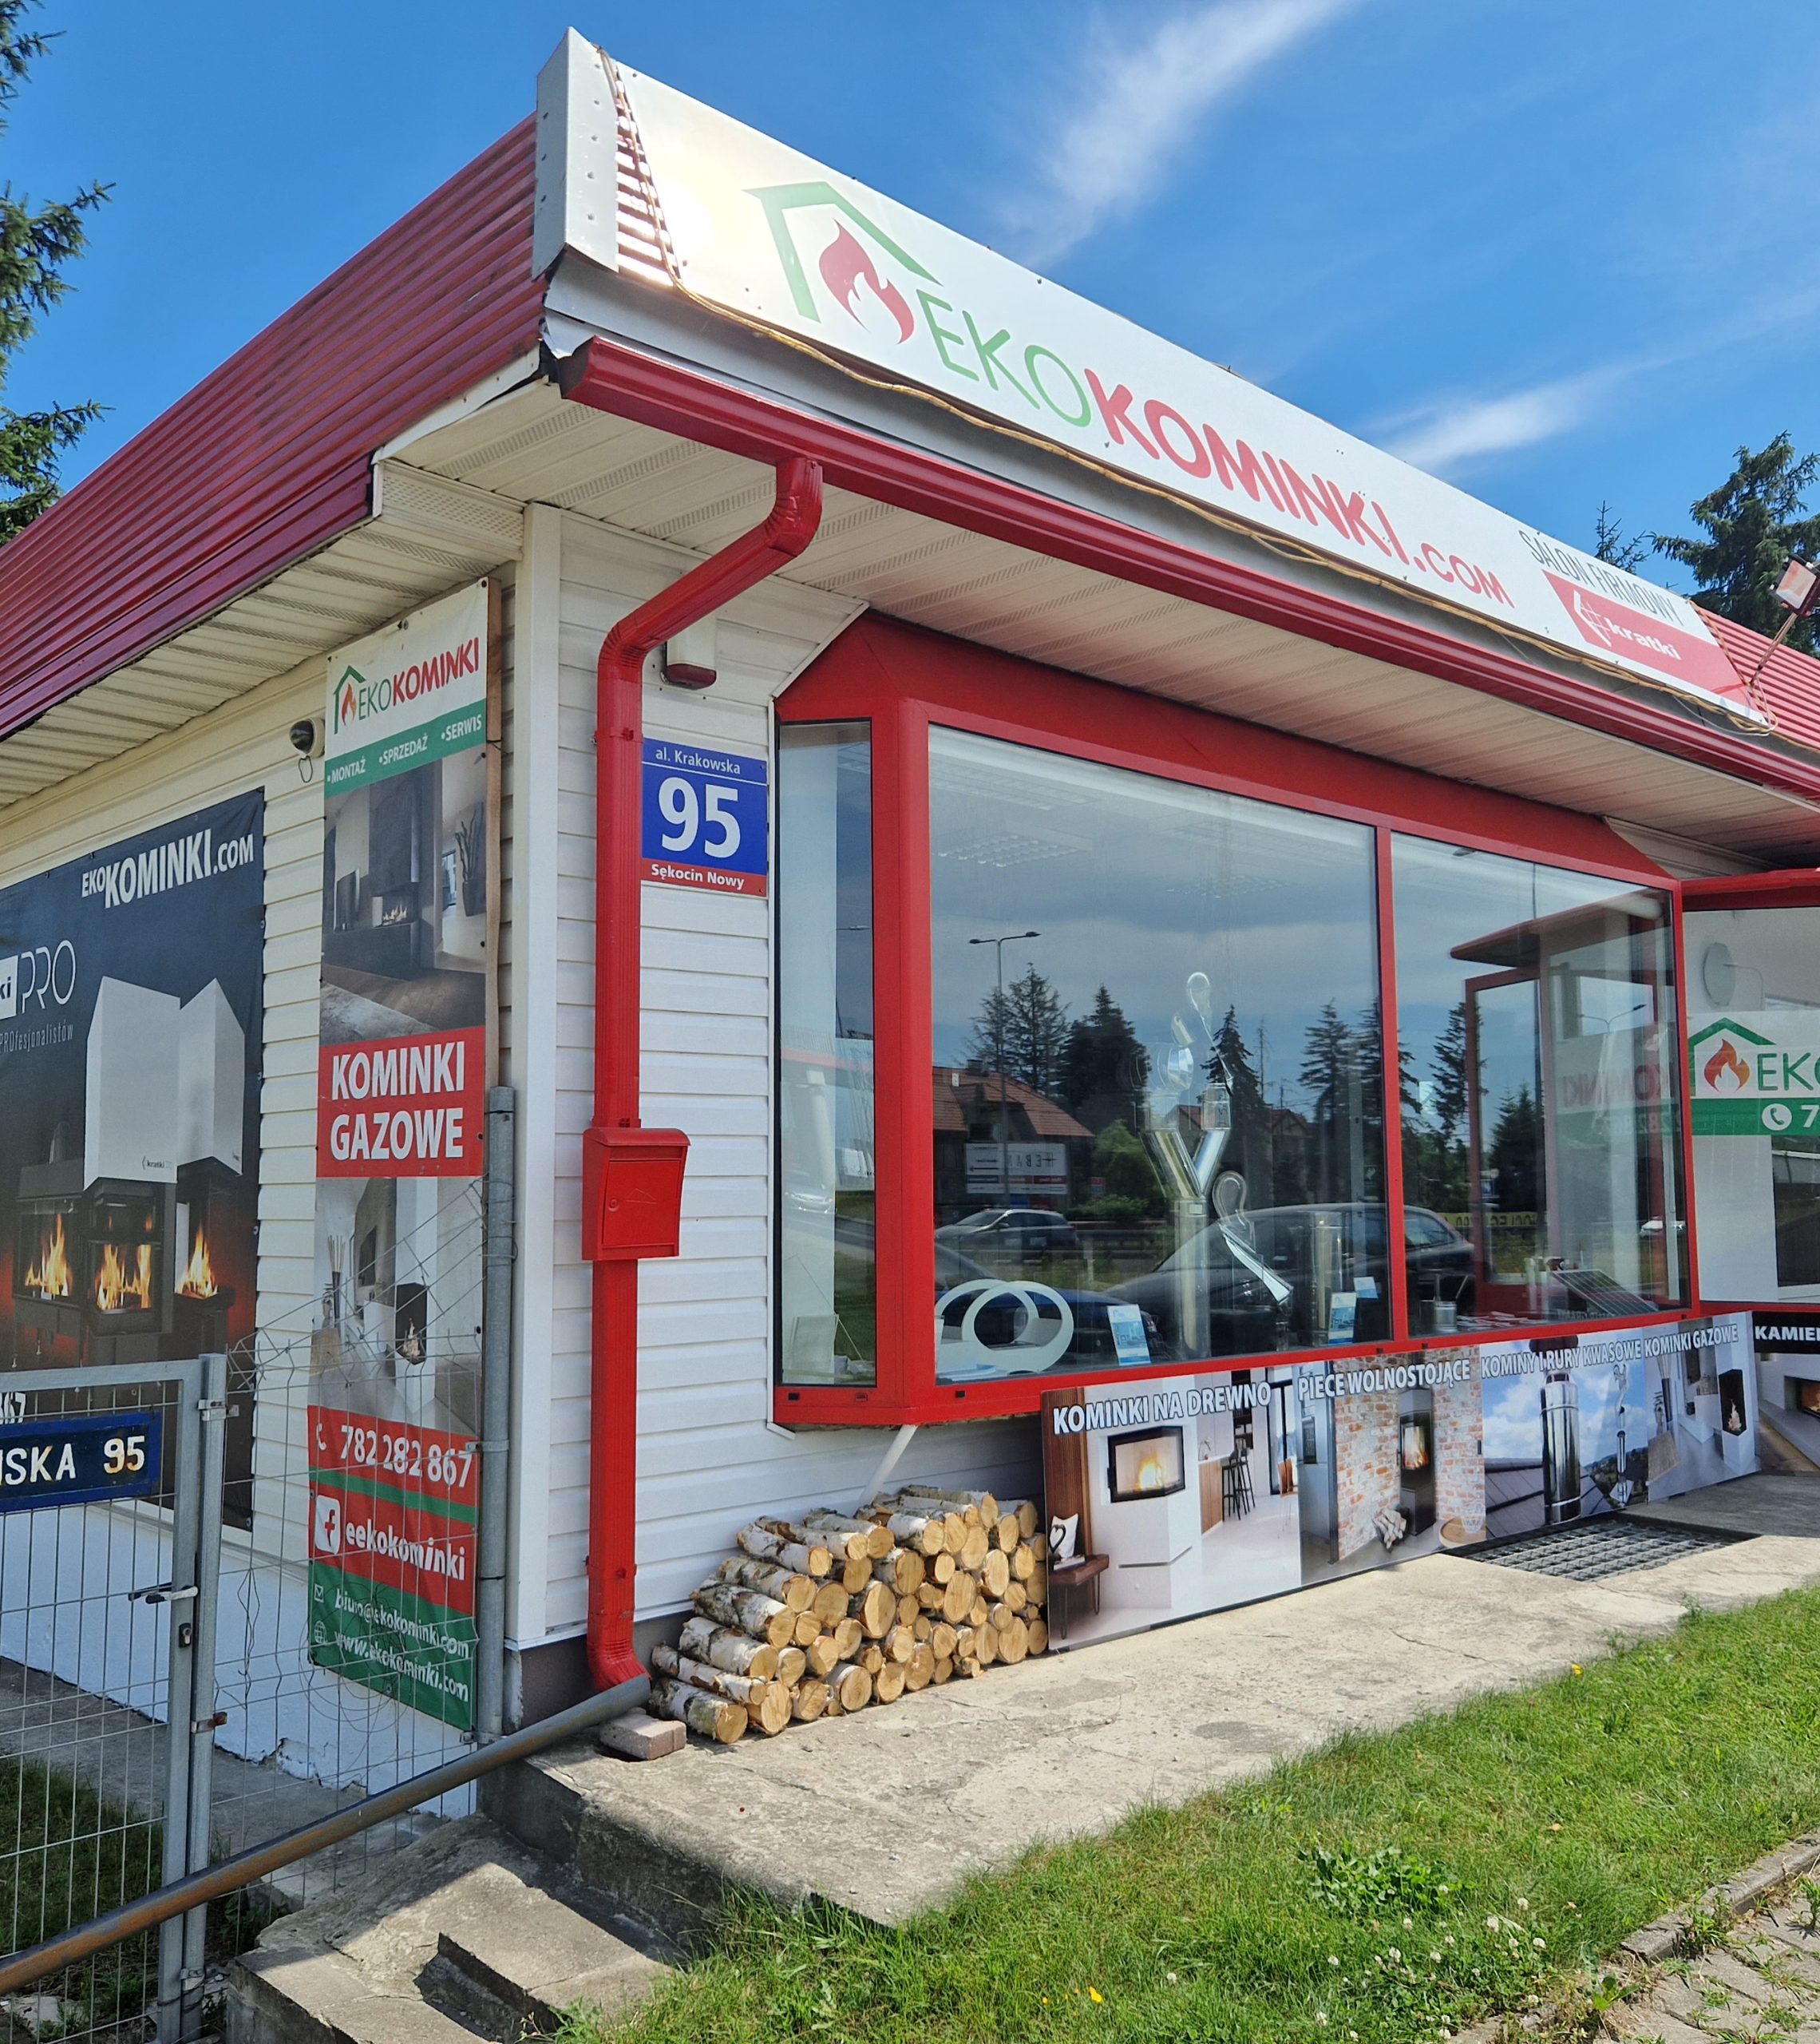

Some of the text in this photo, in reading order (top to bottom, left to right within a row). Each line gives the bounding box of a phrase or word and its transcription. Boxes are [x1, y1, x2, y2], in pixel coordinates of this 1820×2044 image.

[1518, 529, 1684, 626] SALON FIRMOWY
[1603, 616, 1682, 661] kratki
[358, 636, 479, 721] EKOKOMINKI
[655, 747, 741, 774] al. Krakowska
[658, 776, 741, 858] 95
[81, 828, 254, 909] EKOKOMINKI.COM
[651, 863, 745, 890] Sękocin Nowy
[21, 940, 77, 1014] PRO
[331, 1040, 465, 1101] KOMINKI
[330, 1107, 464, 1161] GAZOWE
[1482, 1351, 1538, 1379] KOMINY
[1545, 1346, 1581, 1371] RURY
[1582, 1338, 1641, 1367] KWASOWE
[1644, 1324, 1739, 1357] KOMINKI GAZOWE
[1298, 1358, 1470, 1400] PIECE WOLNOSTOJĄCE
[1053, 1381, 1272, 1435] KOMINKI NA DREWNO
[0, 1436, 145, 1485] SKA 95
[340, 1424, 473, 1488] 782 282 867
[345, 1518, 465, 1581] eekokominki
